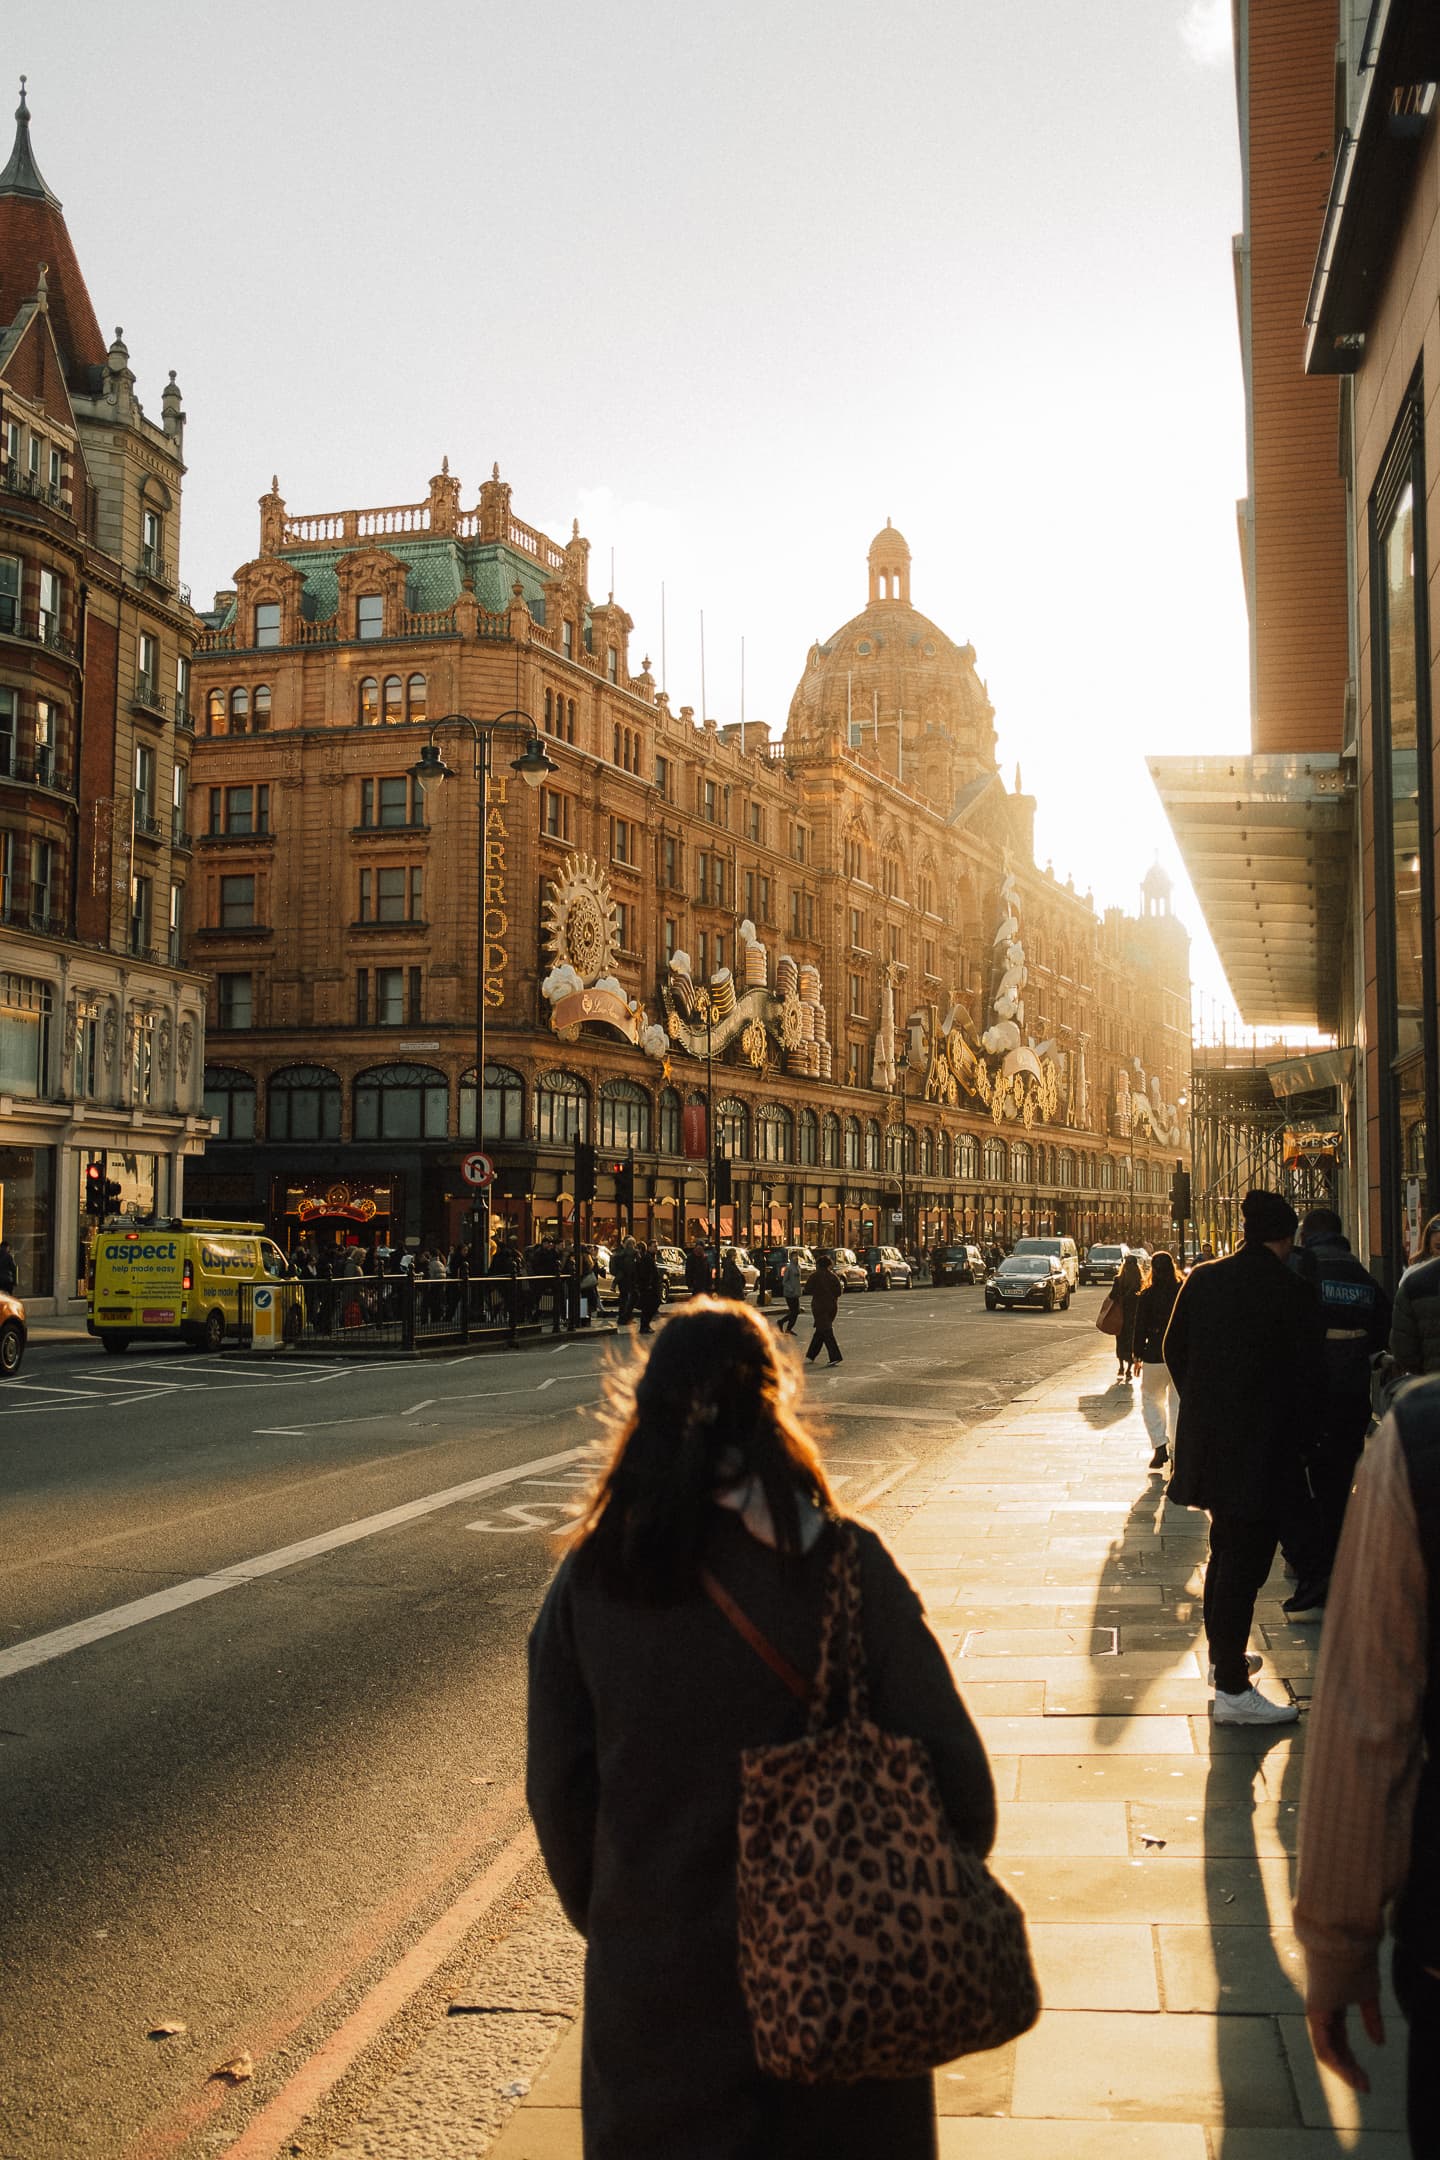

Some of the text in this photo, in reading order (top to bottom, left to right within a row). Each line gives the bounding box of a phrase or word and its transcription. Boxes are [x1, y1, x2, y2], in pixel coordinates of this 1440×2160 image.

[484, 775, 510, 1007] HARRODS
[105, 1242, 177, 1265] aspect
[202, 1243, 255, 1275] aspect
[111, 1265, 129, 1274] help
[130, 1265, 154, 1273] made
[203, 1286, 217, 1297] help
[217, 1287, 234, 1297] made
